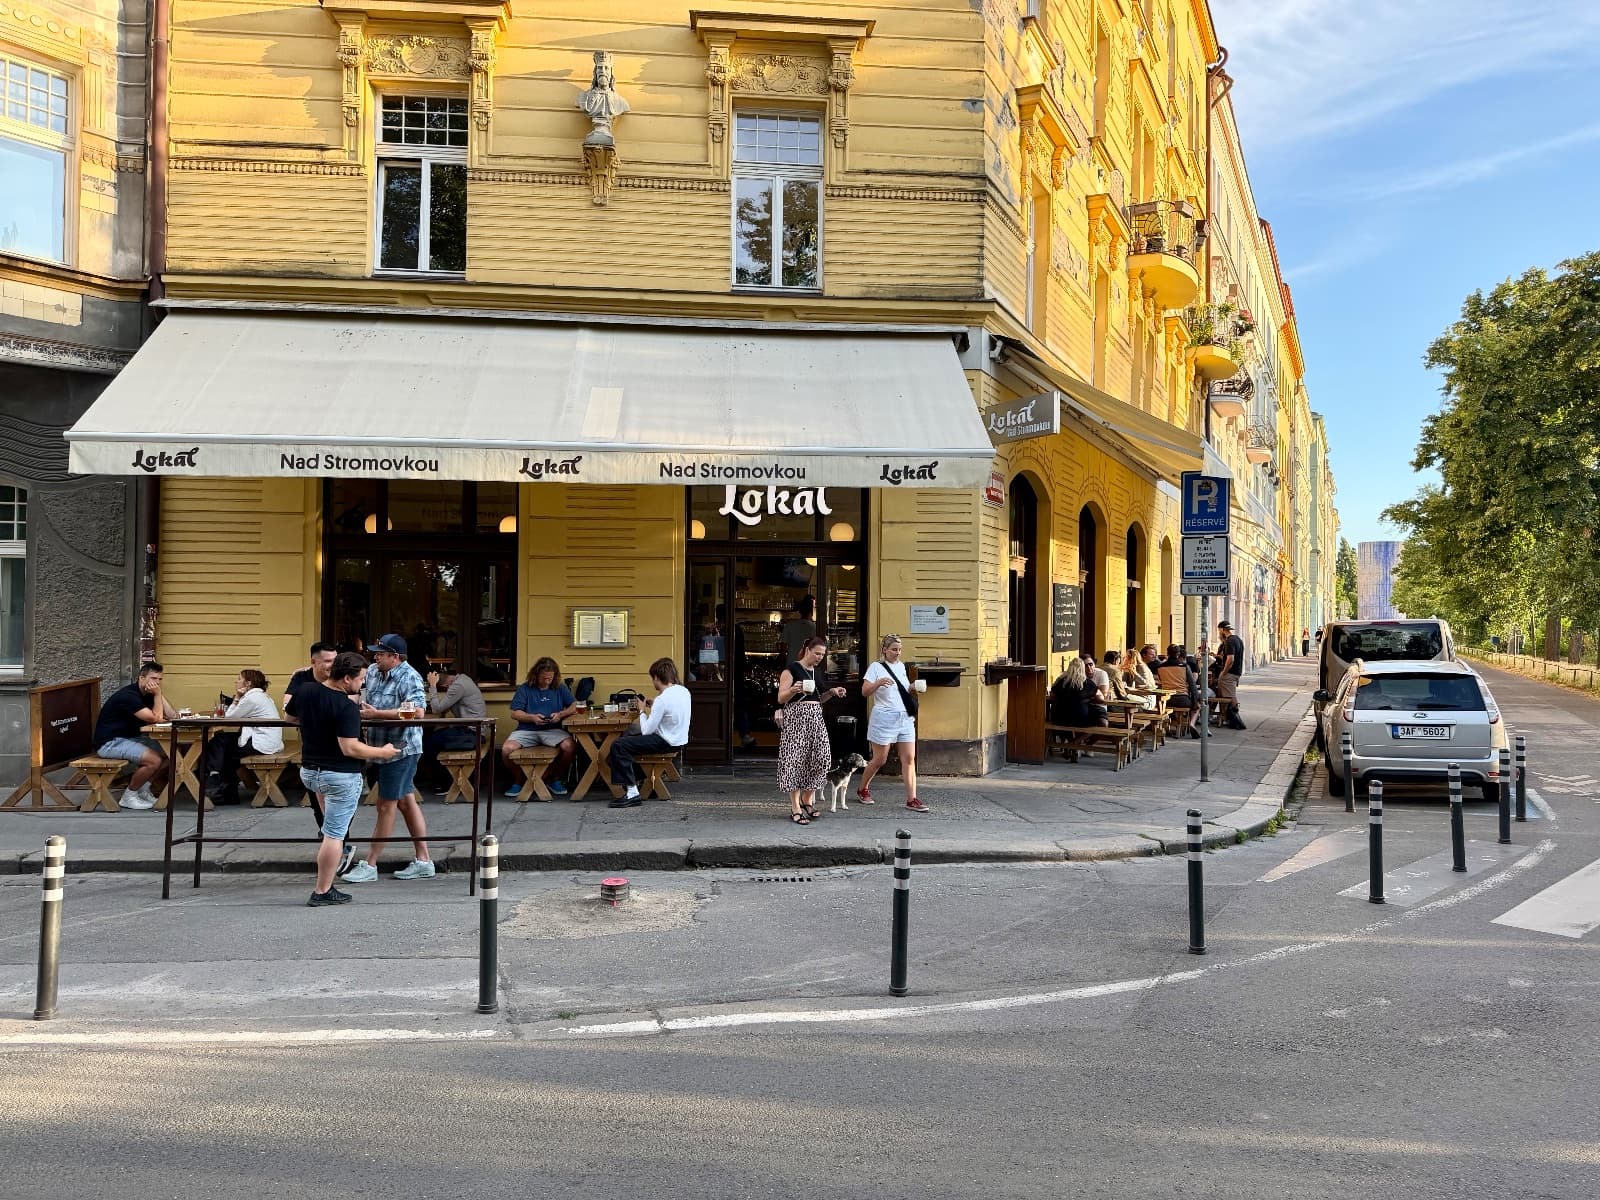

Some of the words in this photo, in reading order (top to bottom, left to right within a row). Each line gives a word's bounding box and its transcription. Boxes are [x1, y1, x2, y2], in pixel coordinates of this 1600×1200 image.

[280, 453, 319, 470] Nad
[323, 454, 439, 472] Stromovkou
[659, 462, 697, 479] Nad
[700, 462, 807, 480] Stromovkou
[1400, 727, 1416, 736] 3AF
[1423, 727, 1445, 736] 5602
